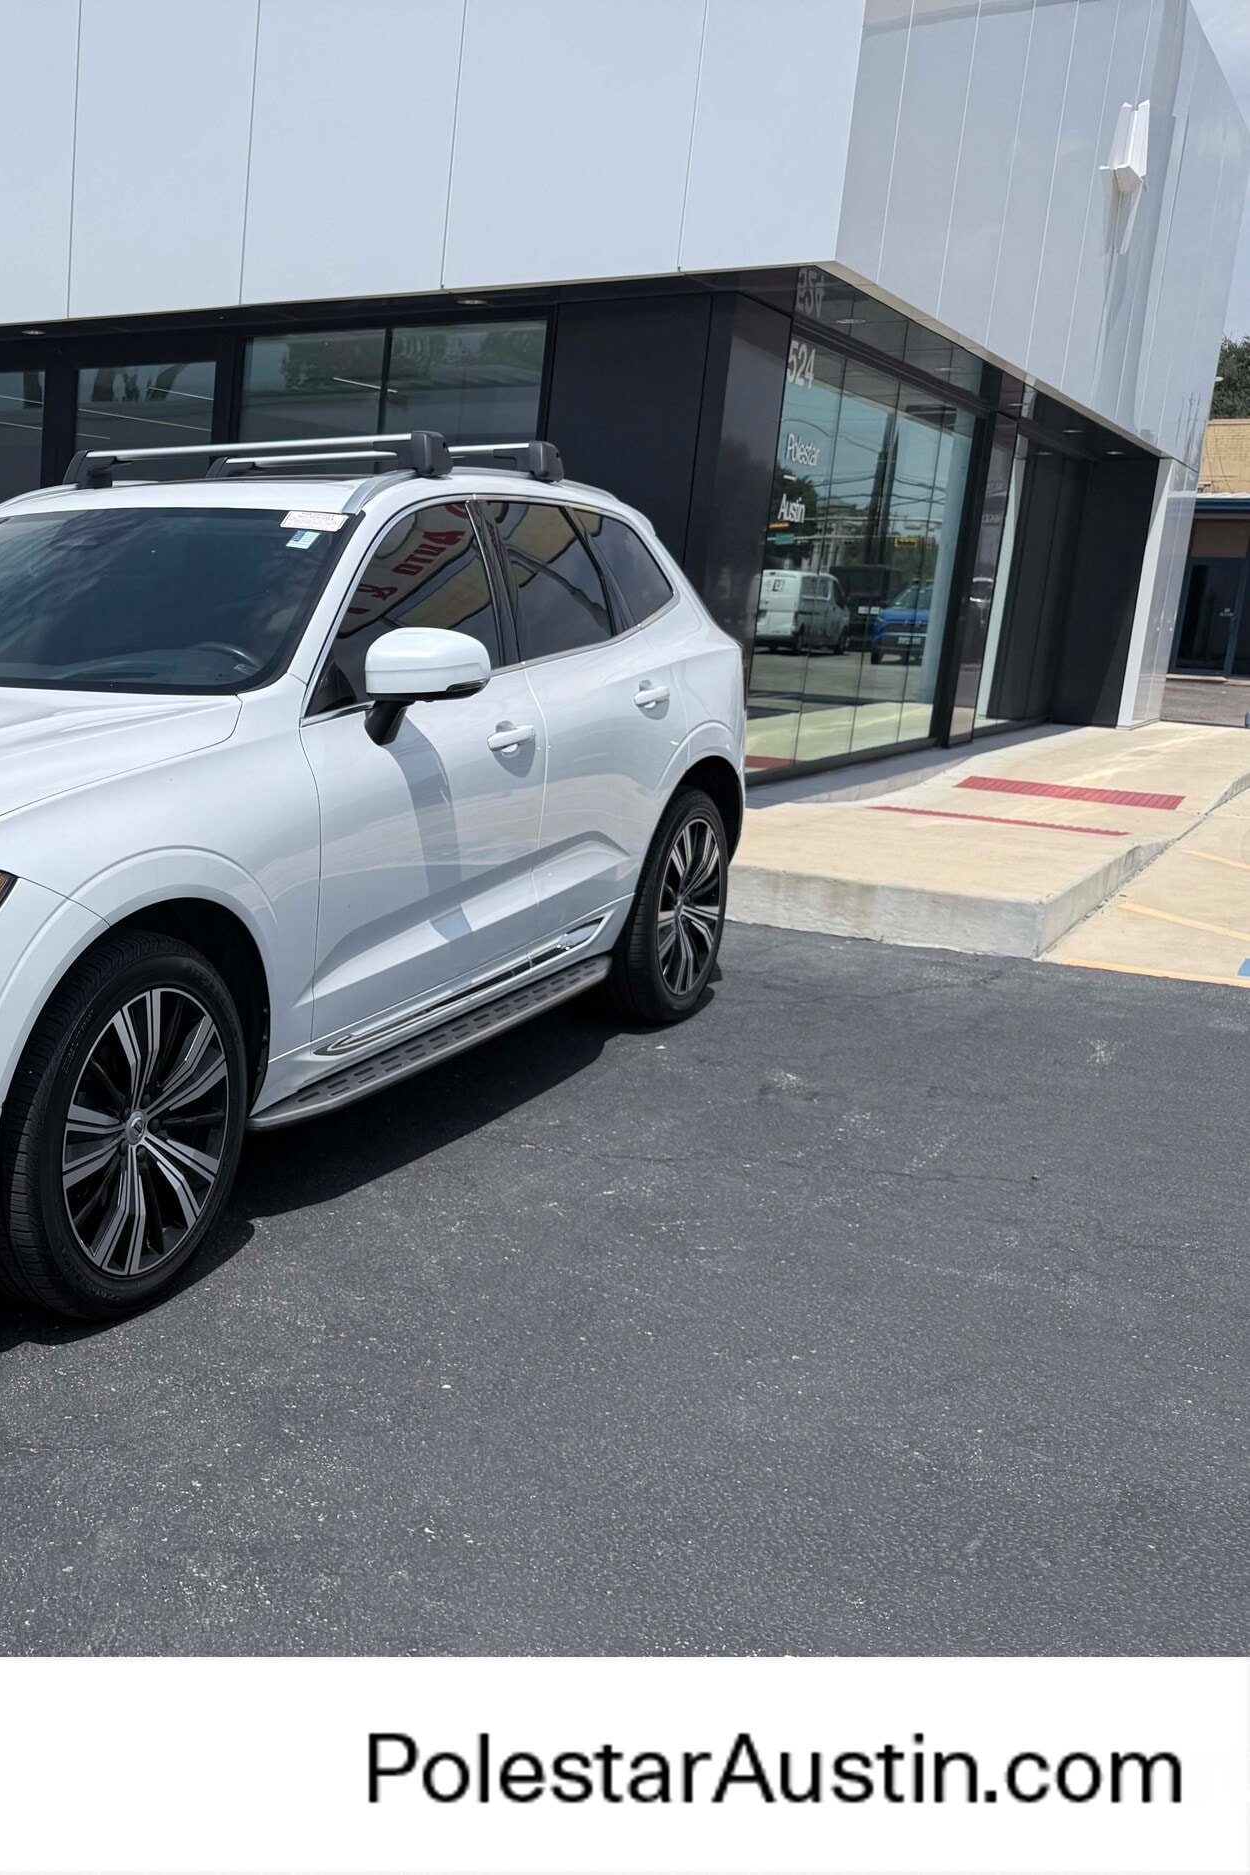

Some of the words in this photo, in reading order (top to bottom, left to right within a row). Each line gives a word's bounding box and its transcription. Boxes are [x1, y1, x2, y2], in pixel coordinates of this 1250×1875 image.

[787, 340, 815, 389] 524
[786, 433, 820, 466] Polestar
[778, 493, 806, 523] Austin
